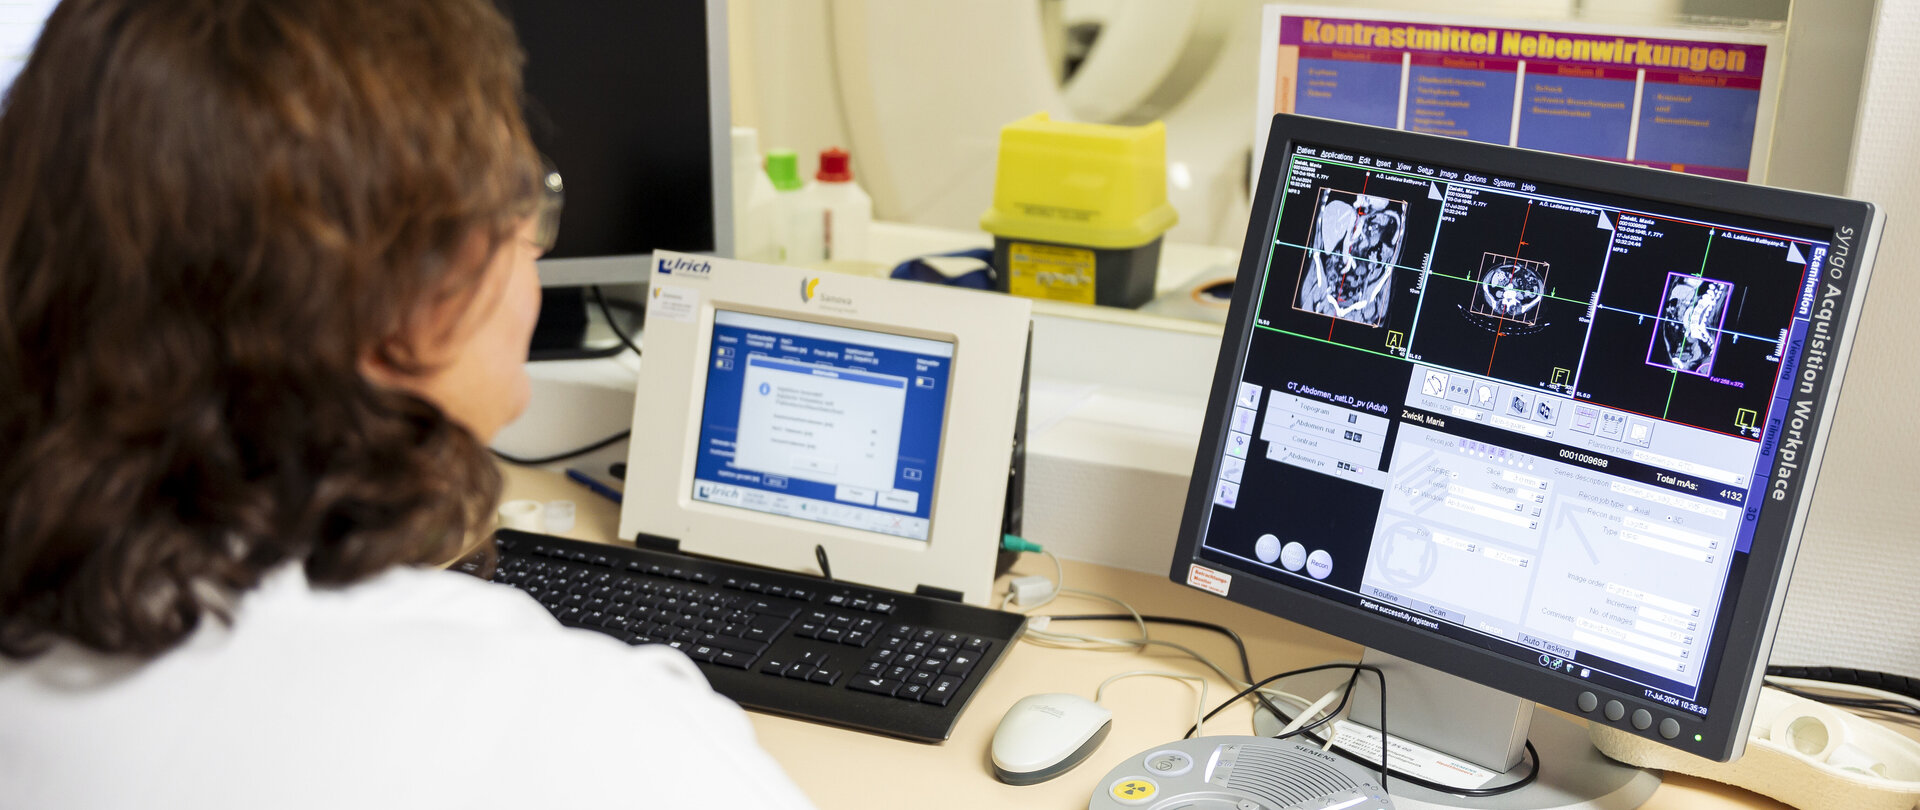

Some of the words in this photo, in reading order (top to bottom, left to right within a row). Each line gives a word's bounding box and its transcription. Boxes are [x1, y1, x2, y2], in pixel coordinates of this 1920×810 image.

[1302, 18, 1497, 55] Kontrastmittel
[1502, 31, 1746, 72] Nebenwirkungen
[1296, 146, 1316, 155] Patient
[1321, 150, 1353, 162] Applications
[1359, 156, 1371, 165] Edit
[1376, 159, 1392, 168] Insert
[1396, 162, 1412, 171] View
[1417, 165, 1434, 175] Setup
[1439, 169, 1458, 179] Image
[1464, 173, 1487, 184] Options
[1493, 178, 1516, 188] System
[1521, 183, 1536, 192] Help
[1830, 226, 1854, 280] syngo
[1798, 247, 1828, 316] Examination
[1390, 334, 1397, 346] A
[1799, 283, 1842, 394] Acquisition
[1782, 338, 1802, 381] Viewing
[1555, 370, 1566, 382] F
[1300, 402, 1330, 415] Topogram
[1366, 401, 1388, 414] (Adult)
[1296, 419, 1325, 432] Abdomen
[1402, 410, 1424, 423] Zwickl,
[1426, 416, 1445, 427] Maria
[1292, 435, 1318, 447] Contrast
[1760, 418, 1781, 457] Filming
[1588, 439, 1615, 453] Planning
[1615, 446, 1633, 456] base
[1771, 400, 1814, 502] Workplace
[1288, 451, 1317, 464] Abdomen
[1559, 449, 1608, 467] 0001009698
[1553, 467, 1573, 478] Series
[1574, 472, 1609, 488] description
[1656, 473, 1676, 484] Total
[1677, 477, 1698, 490] mAs:
[1720, 489, 1742, 501] 4132
[1634, 506, 1650, 515] Axial
[1745, 505, 1758, 523] 3D
[1602, 526, 1618, 537] Type
[1311, 559, 1329, 570] Recon
[1373, 588, 1398, 602] Routine
[1360, 599, 1379, 611] Patient
[1379, 604, 1411, 622] successfully
[1411, 612, 1440, 630] registered.
[1428, 605, 1446, 617] Scan
[1541, 607, 1575, 623] Comments
[1479, 621, 1503, 635] Recon
[1608, 614, 1633, 626] images
[1523, 635, 1540, 648] Auto
[1542, 639, 1571, 657] Tasking
[1644, 689, 1679, 706] 17-Jul-2024
[1294, 745, 1337, 763] SIEMENS
